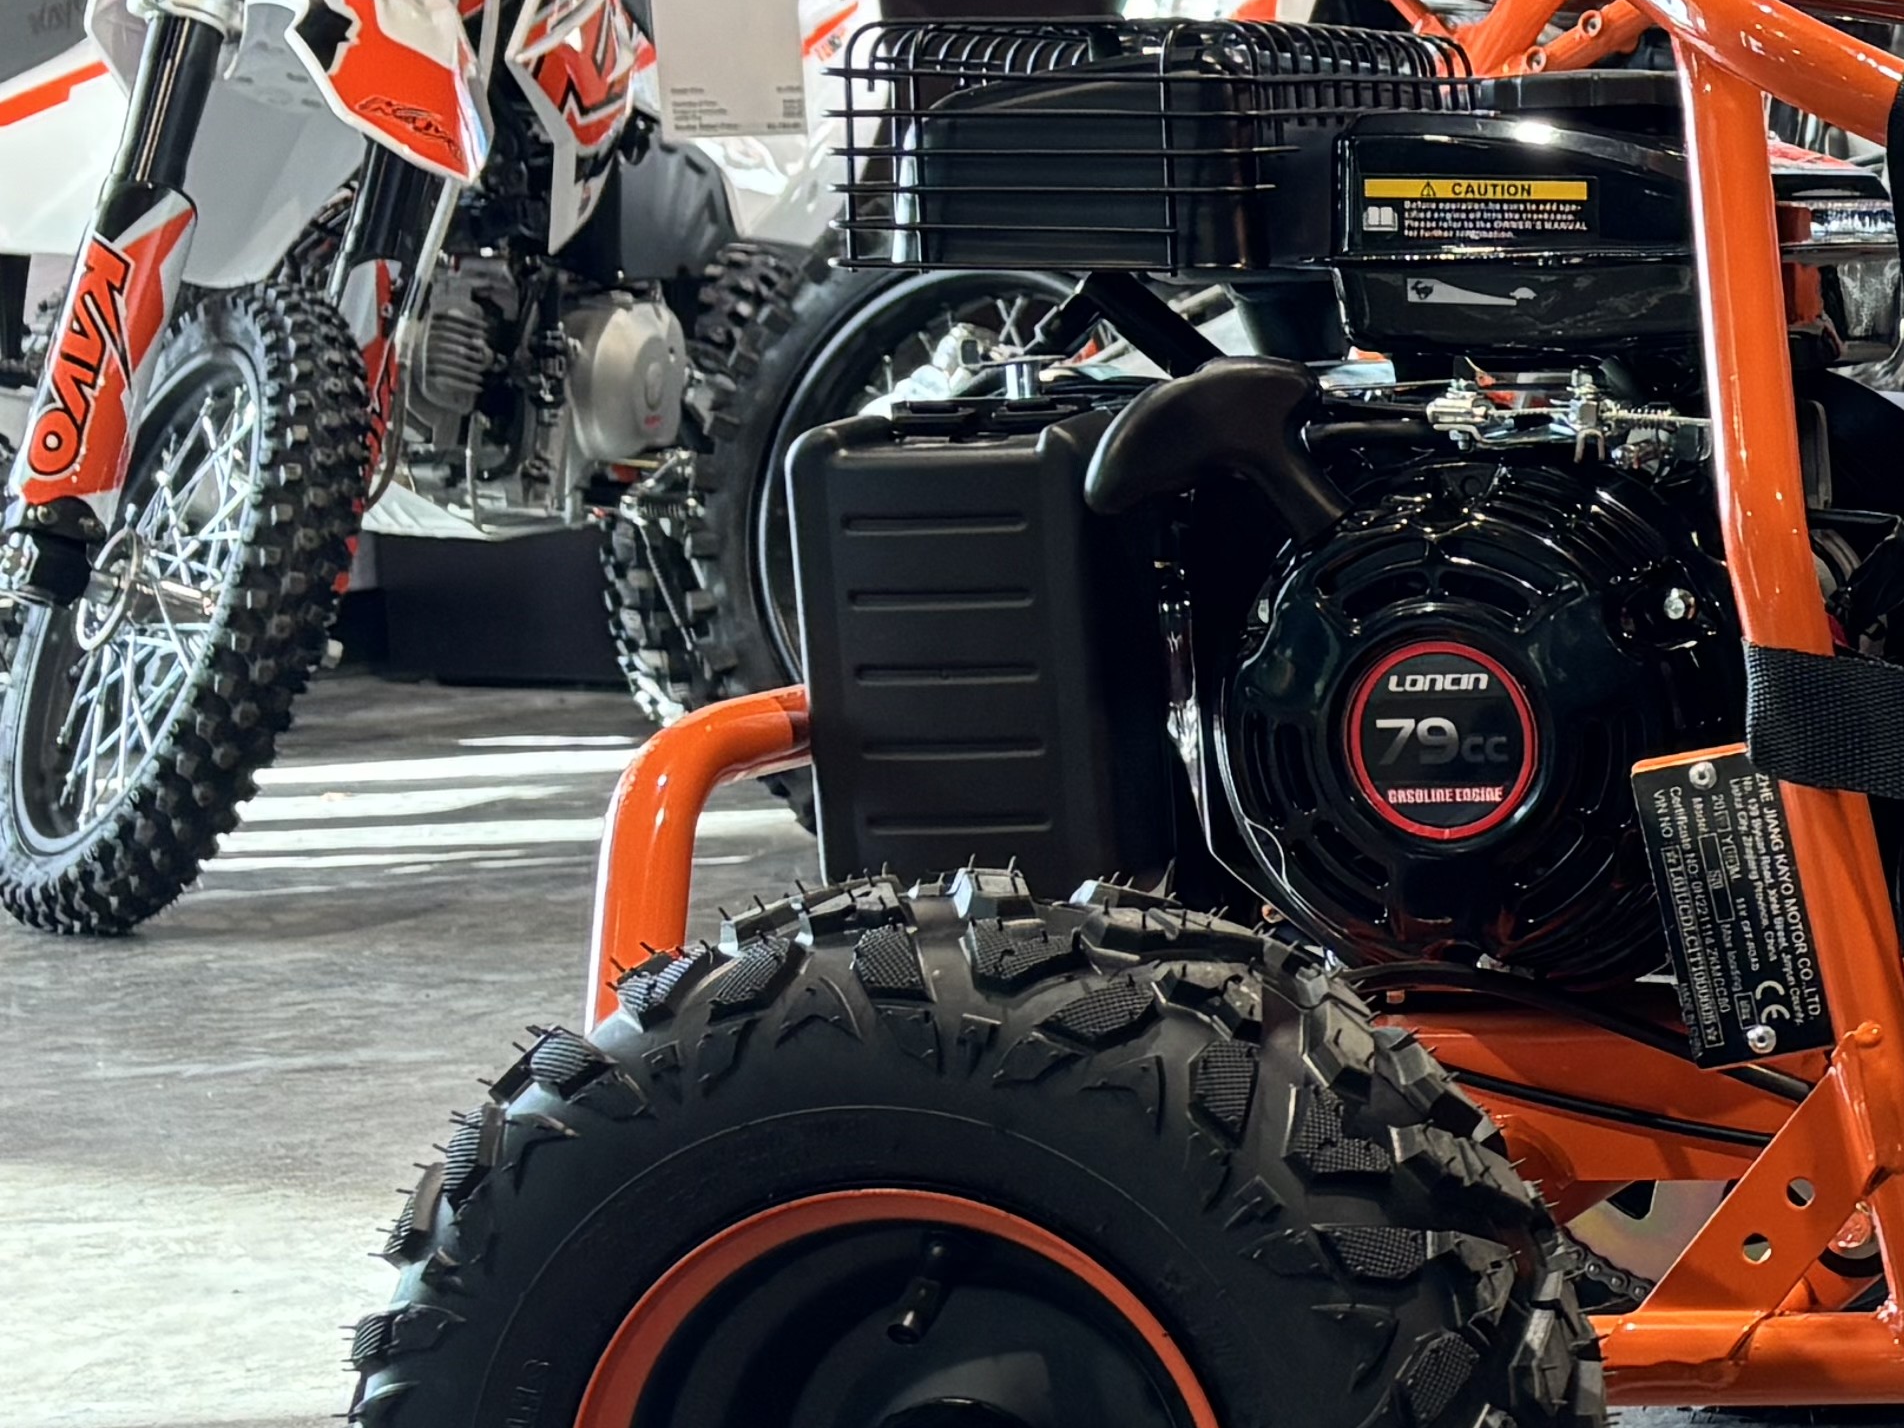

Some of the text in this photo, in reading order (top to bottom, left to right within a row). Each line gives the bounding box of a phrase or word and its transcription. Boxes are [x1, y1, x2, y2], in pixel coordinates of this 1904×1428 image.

[1451, 182, 1532, 197] CAUTION
[28, 233, 131, 475] KAYO
[1387, 673, 1489, 692] LONCIN
[1387, 785, 1503, 804] GASOLINE ENGINE
[1651, 789, 1668, 814] VIN
[1754, 771, 1774, 804] ZHE
[1762, 805, 1785, 852] JIANG
[1772, 853, 1795, 896] KAYO
[1782, 897, 1808, 955] MOTOR
